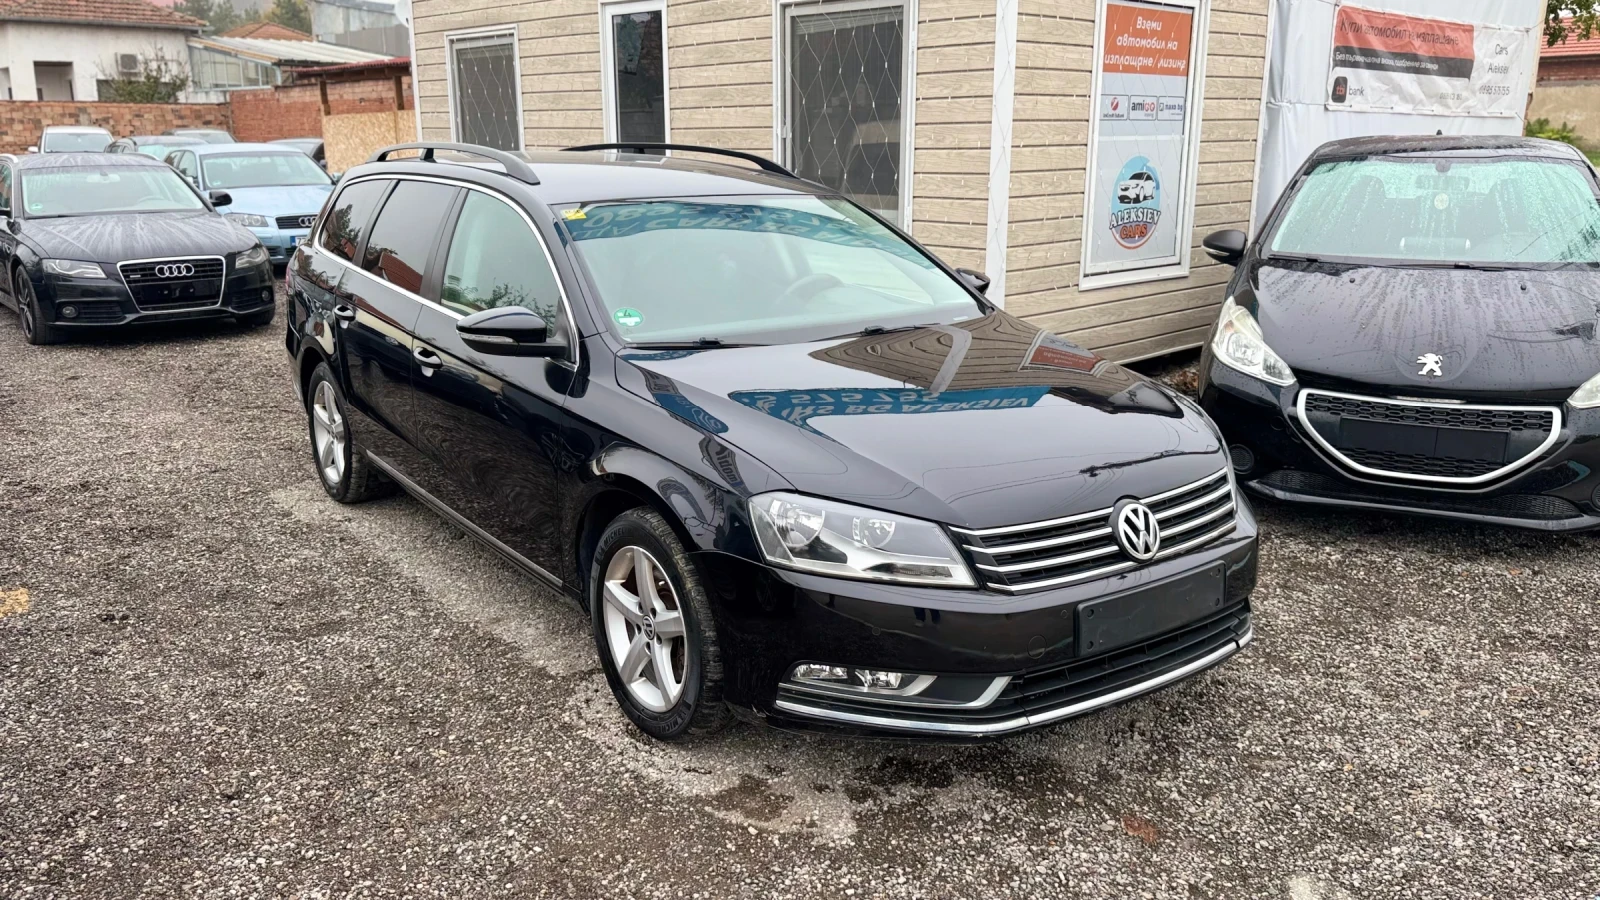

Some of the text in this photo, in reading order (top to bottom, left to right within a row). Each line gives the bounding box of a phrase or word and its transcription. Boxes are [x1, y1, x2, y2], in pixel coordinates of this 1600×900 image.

[1136, 16, 1162, 31] Вземи
[1340, 18, 1363, 34] Купи
[1116, 33, 1178, 51] автомобил на
[1494, 43, 1509, 56] Cars
[1105, 54, 1153, 67] изплащане
[1158, 58, 1186, 71] лизинг
[1348, 84, 1365, 96] bank
[1109, 207, 1161, 229] ALEKSIEV
[1120, 224, 1147, 239] CARS
[623, 309, 632, 318] 4
